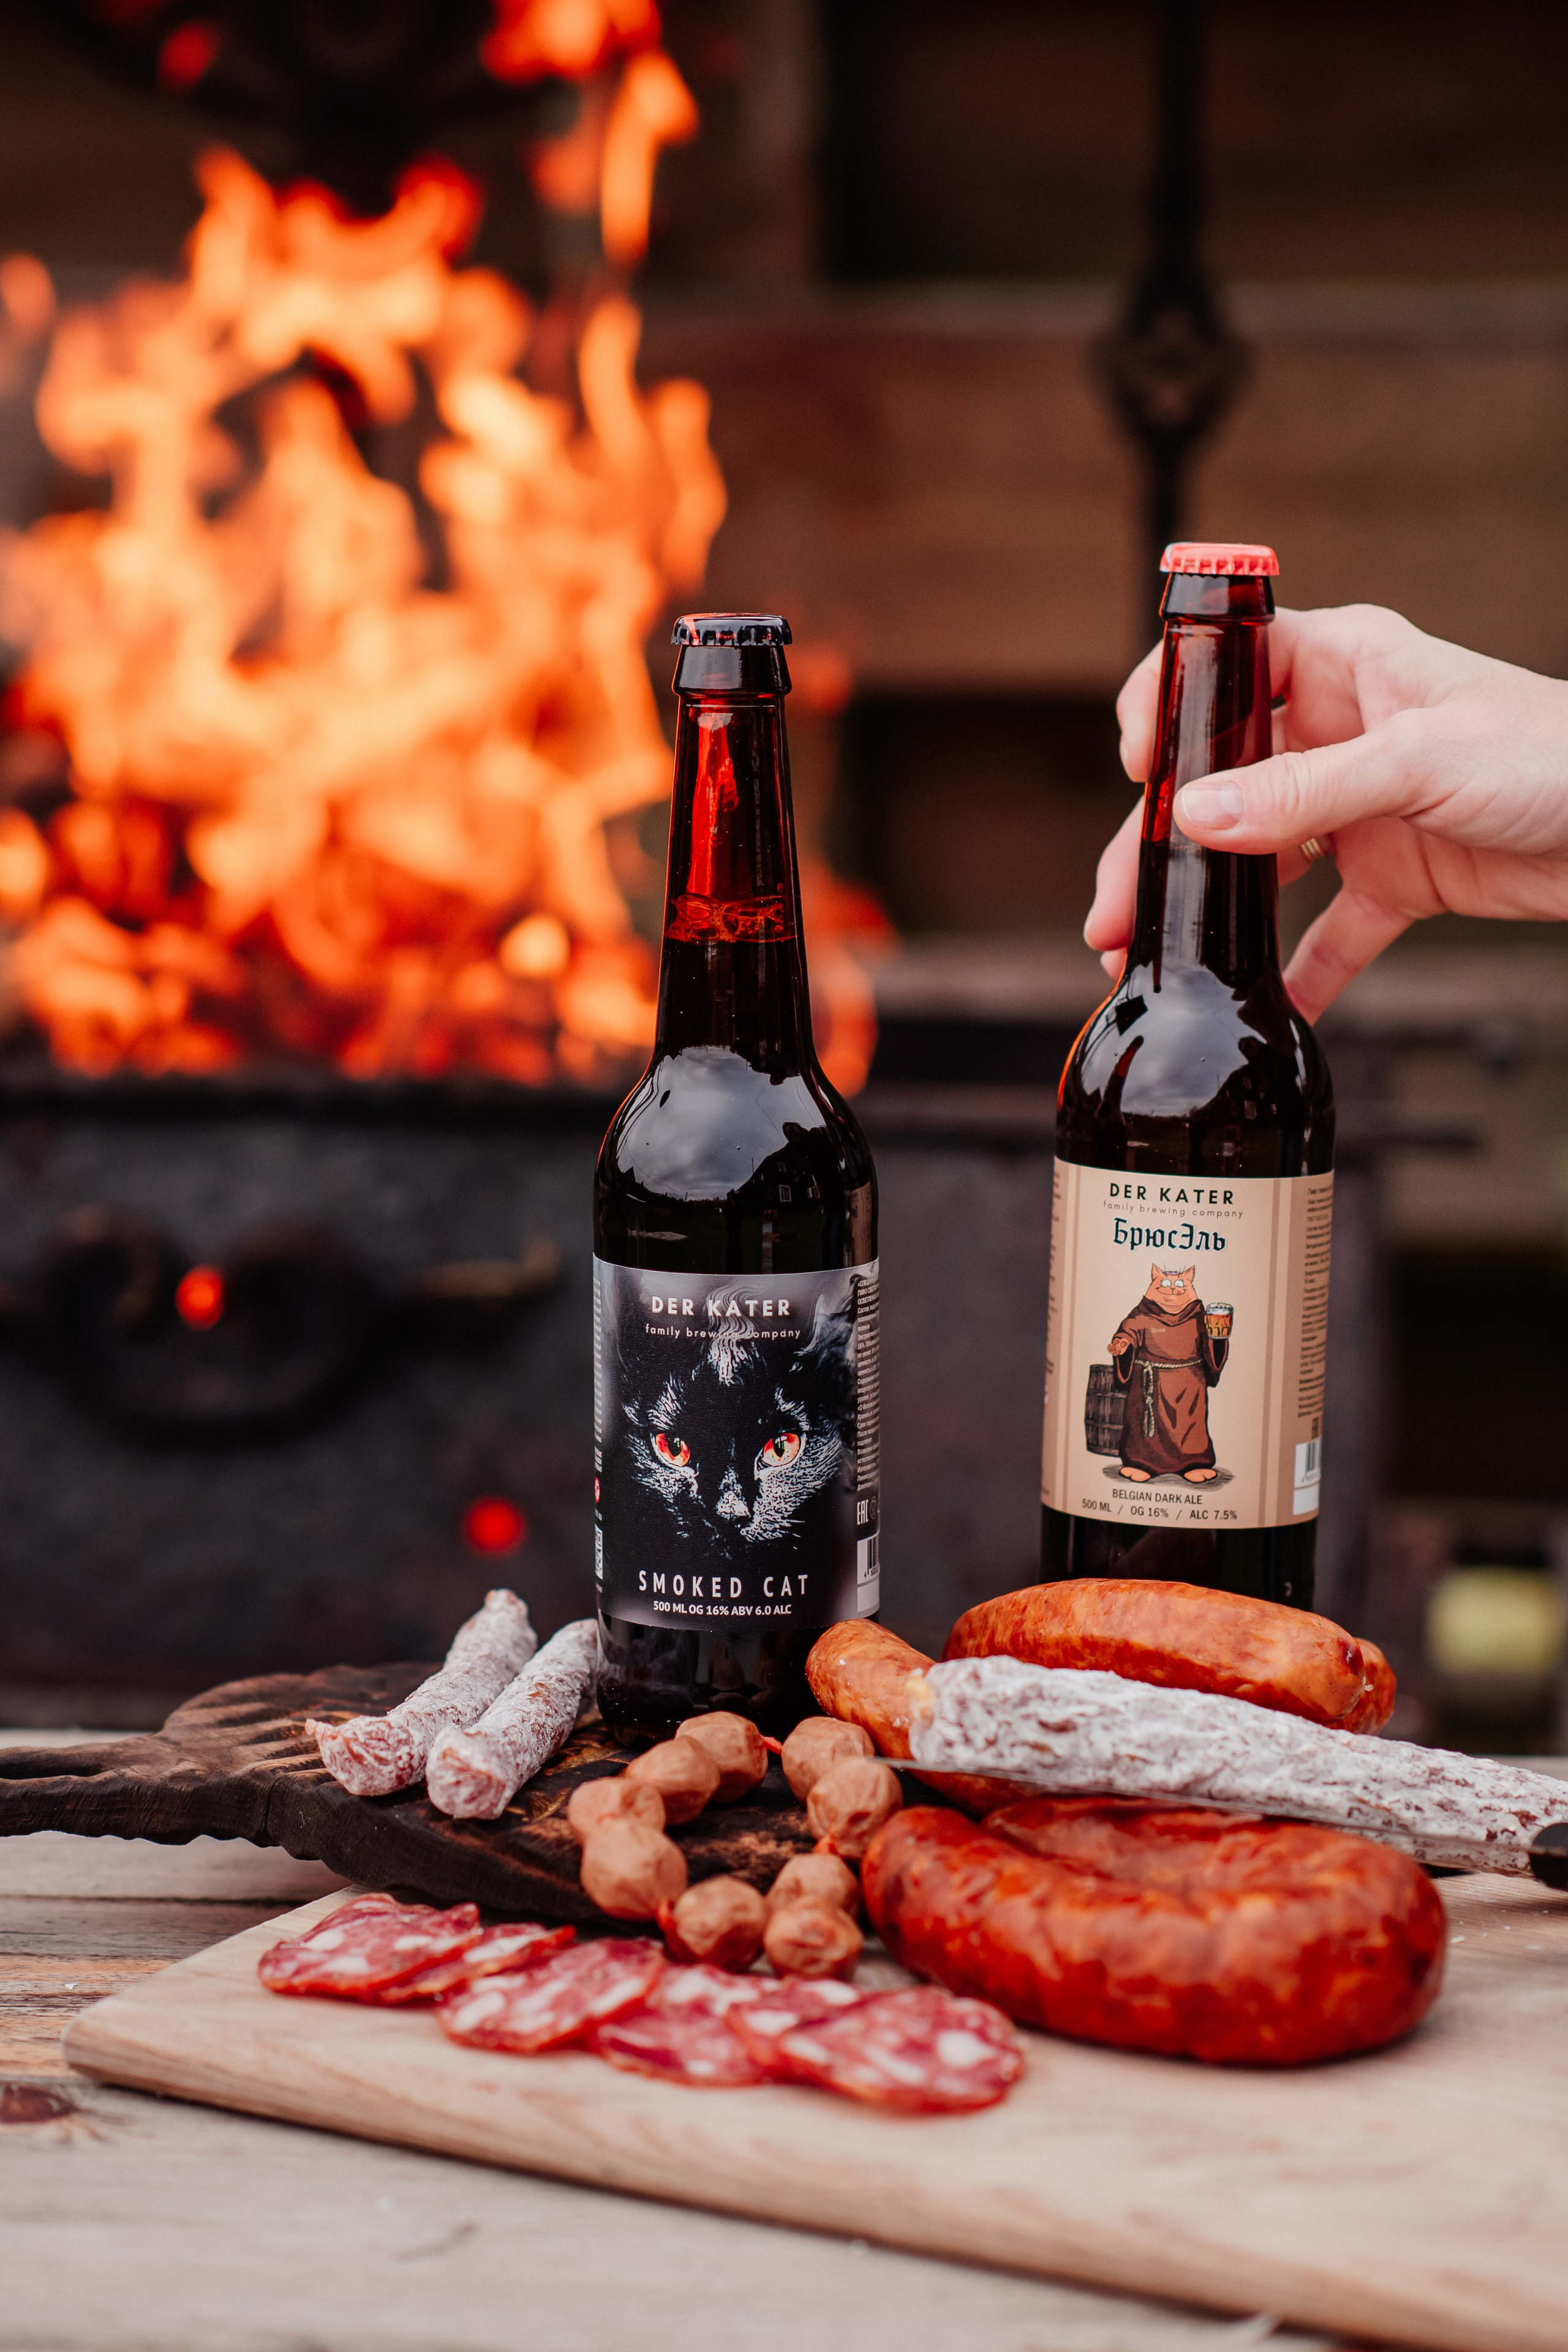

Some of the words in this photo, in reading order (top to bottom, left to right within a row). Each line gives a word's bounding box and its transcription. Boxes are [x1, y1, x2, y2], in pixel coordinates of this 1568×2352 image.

[1109, 1183, 1147, 1200] DER
[1159, 1187, 1234, 1205] KATER
[1103, 1200, 1134, 1213] family
[1139, 1204, 1186, 1218] brewing
[1192, 1209, 1243, 1219] company
[1112, 1217, 1226, 1251] БрюсЭль
[651, 1295, 695, 1316] DER
[707, 1299, 790, 1317] KATER
[645, 1323, 680, 1339] family
[686, 1327, 738, 1340] brewing
[745, 1329, 801, 1340] company
[1112, 1488, 1152, 1502] BELGIAN
[1155, 1493, 1182, 1504] DARK
[1184, 1494, 1203, 1505] ALE
[1082, 1498, 1098, 1510] 500
[1099, 1501, 1112, 1512] ML
[1131, 1506, 1144, 1516] OG
[1148, 1507, 1169, 1518] 16%
[1189, 1510, 1209, 1520] ALC
[1214, 1510, 1237, 1520] 7.5%
[639, 1570, 742, 1598] SMOKED
[763, 1574, 808, 1597] CAT
[653, 1600, 671, 1612] 500
[673, 1602, 687, 1614] ML
[688, 1604, 704, 1615] OG
[706, 1605, 729, 1615] 16%
[731, 1605, 753, 1616] ABV
[755, 1605, 771, 1616] 6.0
[773, 1604, 791, 1615] ALC
